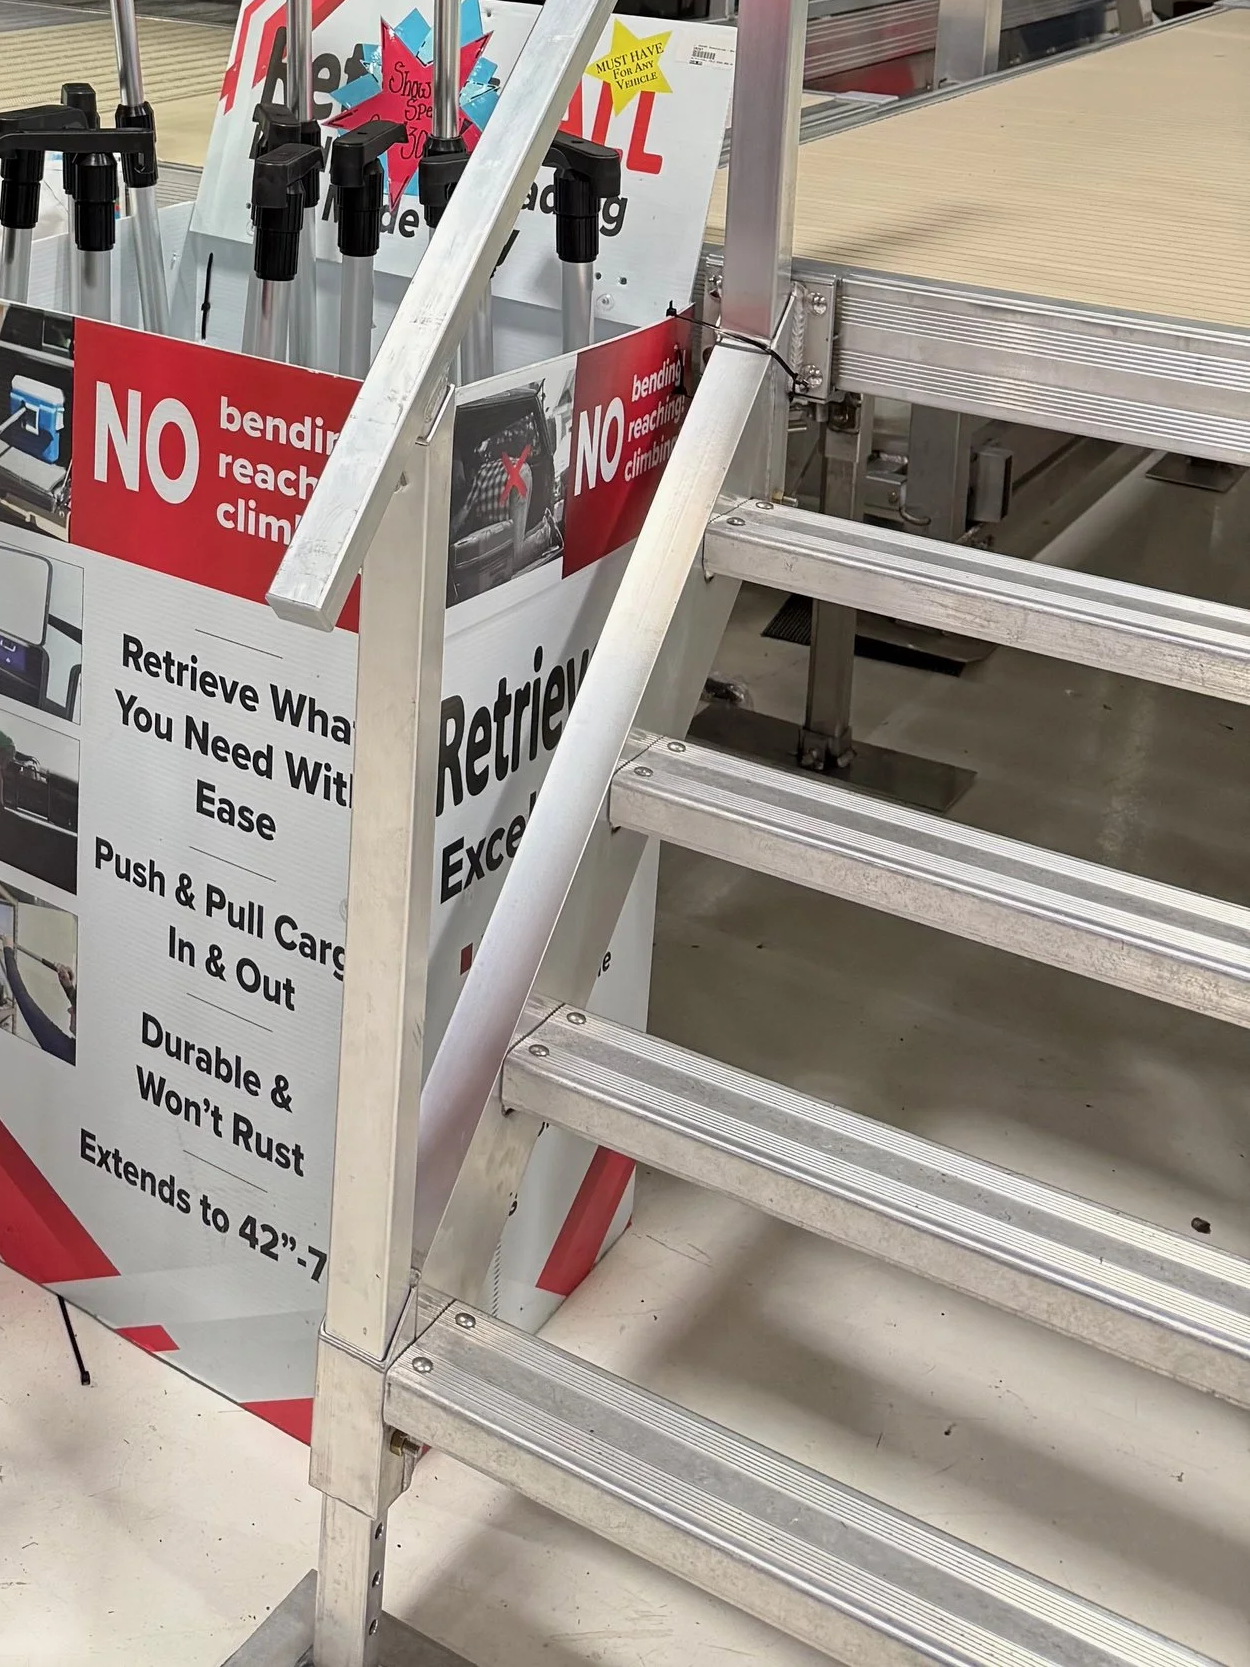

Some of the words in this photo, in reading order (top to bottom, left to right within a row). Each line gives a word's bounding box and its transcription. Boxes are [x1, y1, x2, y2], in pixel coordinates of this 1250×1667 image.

[388, 61, 432, 101] Show
[596, 53, 629, 74] MUST
[629, 42, 665, 63] HAVE
[93, 380, 200, 505] NO
[574, 396, 625, 497] NO
[122, 632, 260, 713] Retrieve
[269, 683, 356, 747] Wha
[114, 688, 174, 744] You
[184, 714, 274, 781] Need
[284, 749, 353, 810] Wit
[196, 778, 277, 842] Ease
[95, 835, 166, 898] Push
[175, 872, 196, 912] &
[205, 882, 264, 940] Pull
[274, 914, 345, 983] Carg
[168, 924, 196, 968] In
[205, 943, 227, 983] &
[235, 957, 296, 1012] Out
[141, 1011, 262, 1098] Durable
[270, 1073, 293, 1114] &
[136, 1064, 223, 1139] Won’t
[232, 1111, 305, 1178] Rust
[80, 1127, 192, 1215] Extends
[199, 1193, 231, 1235] to
[238, 1213, 328, 1284] 42”-7
